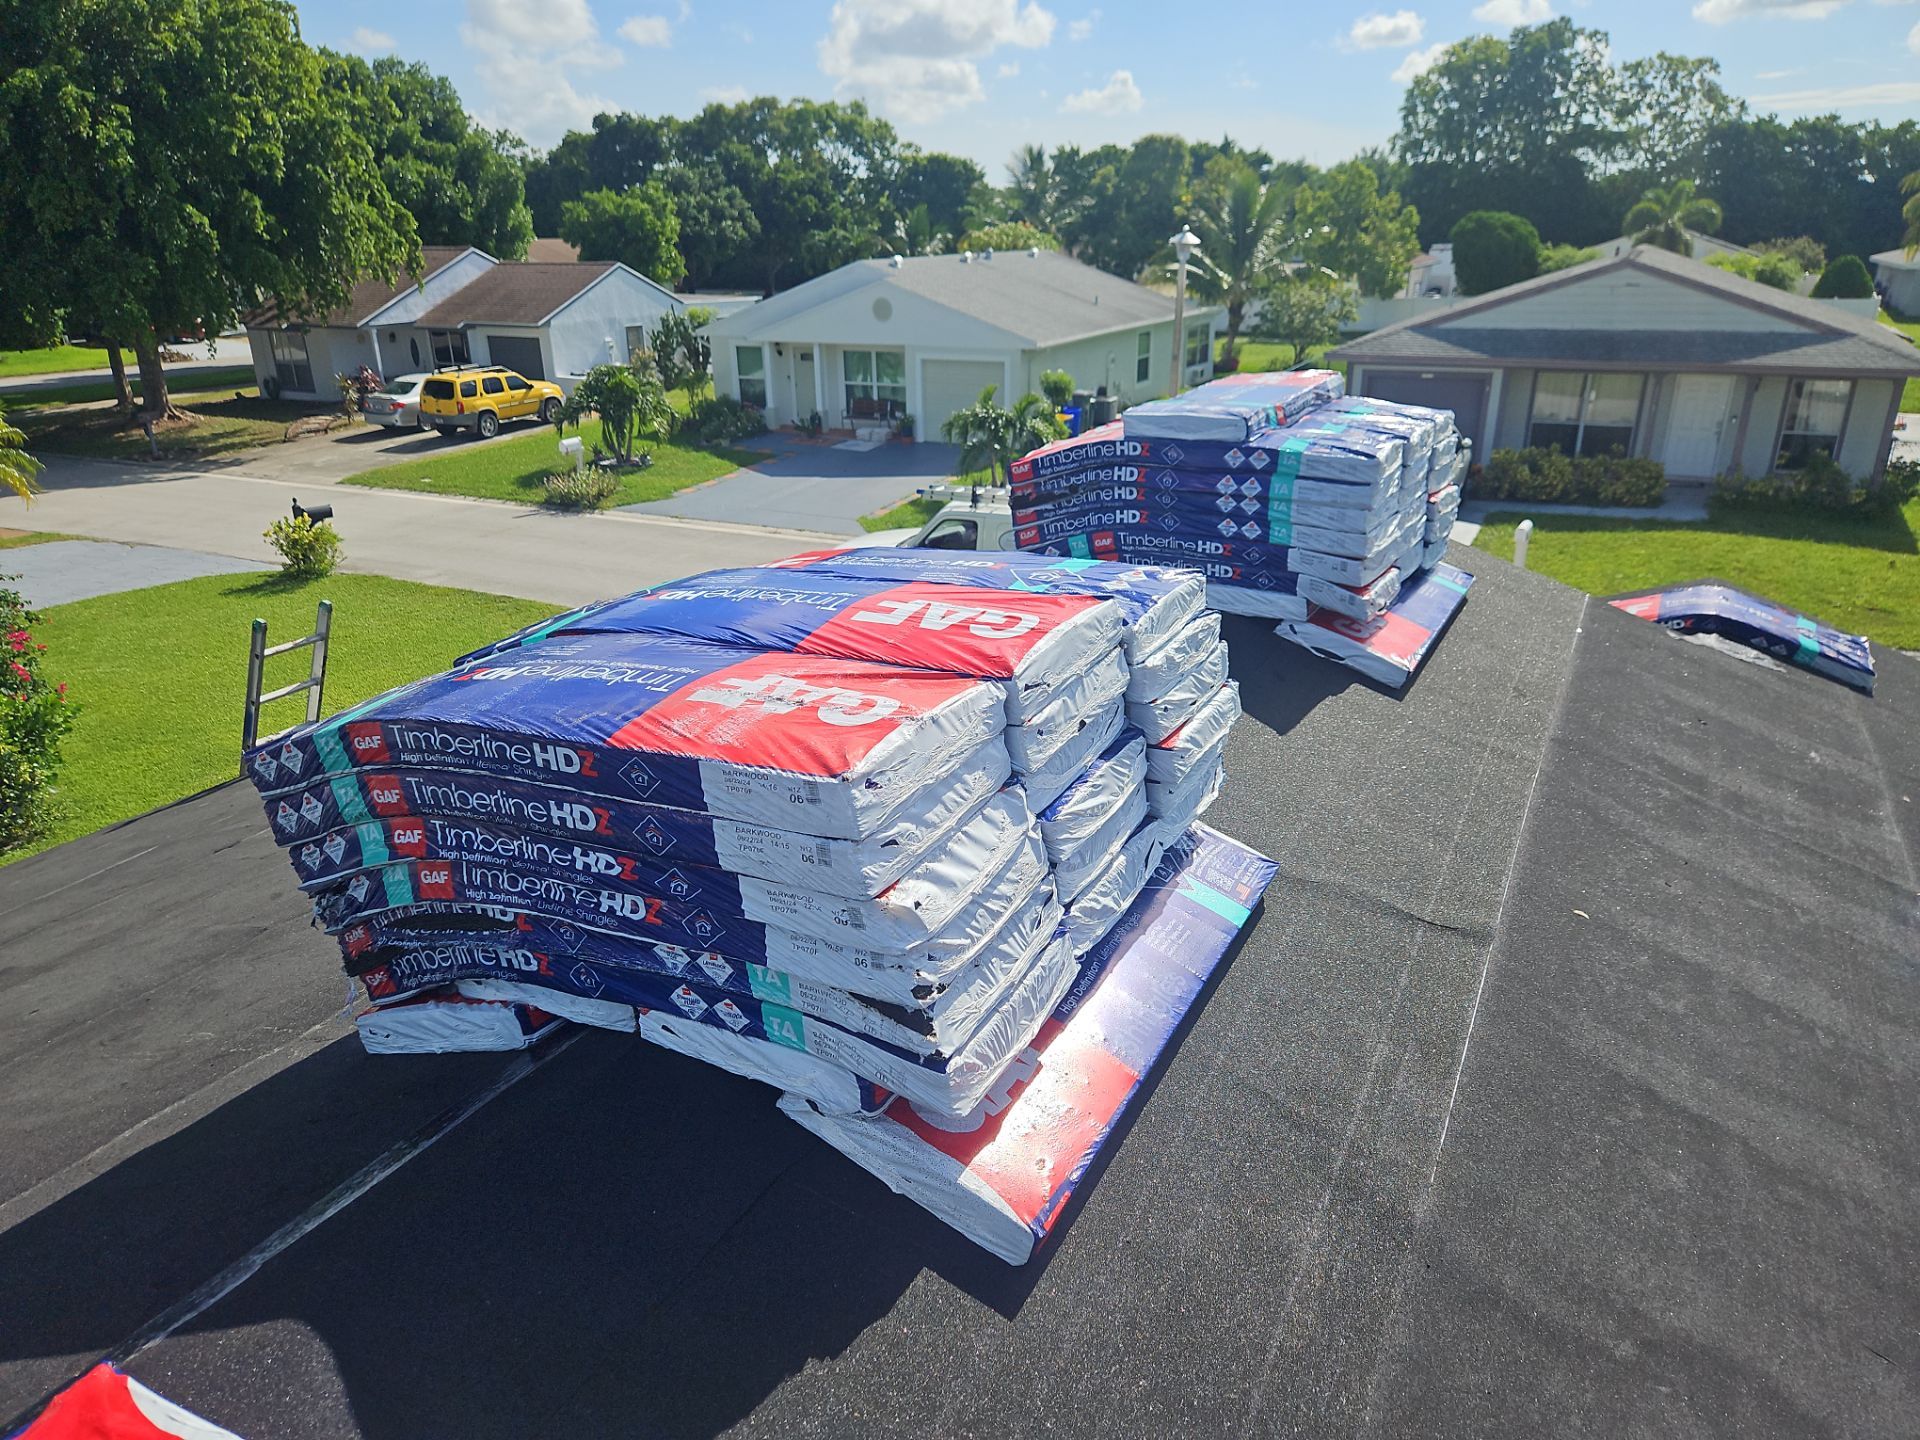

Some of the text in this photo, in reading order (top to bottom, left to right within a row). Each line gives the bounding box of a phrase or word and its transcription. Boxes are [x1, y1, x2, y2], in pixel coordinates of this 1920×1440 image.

[1012, 464, 1031, 474] GAF
[1274, 484, 1289, 495] TA
[1274, 502, 1288, 512] TA
[1274, 528, 1288, 537] TA
[1095, 538, 1112, 546] GAF
[852, 599, 1043, 638] GAF
[686, 674, 902, 727] GAF
[354, 735, 381, 750] GAF
[401, 752, 422, 764] High
[425, 753, 469, 765] Definition
[721, 769, 769, 782] BARKWOOD
[373, 789, 400, 804] GAF
[789, 793, 804, 804] 06
[361, 826, 381, 842] TA
[393, 829, 422, 844] GAF
[735, 826, 782, 840] BARKWOOD
[801, 854, 815, 864] 06
[439, 849, 460, 861] High
[462, 852, 507, 866] Definition
[552, 868, 594, 886] Shingles
[420, 870, 448, 884] GAF
[466, 888, 487, 902] High
[576, 908, 618, 927] Shingles
[854, 957, 868, 969] 06
[1059, 995, 1079, 1014] High
[1074, 961, 1102, 996] Definition
[1118, 912, 1142, 936] Shingles
